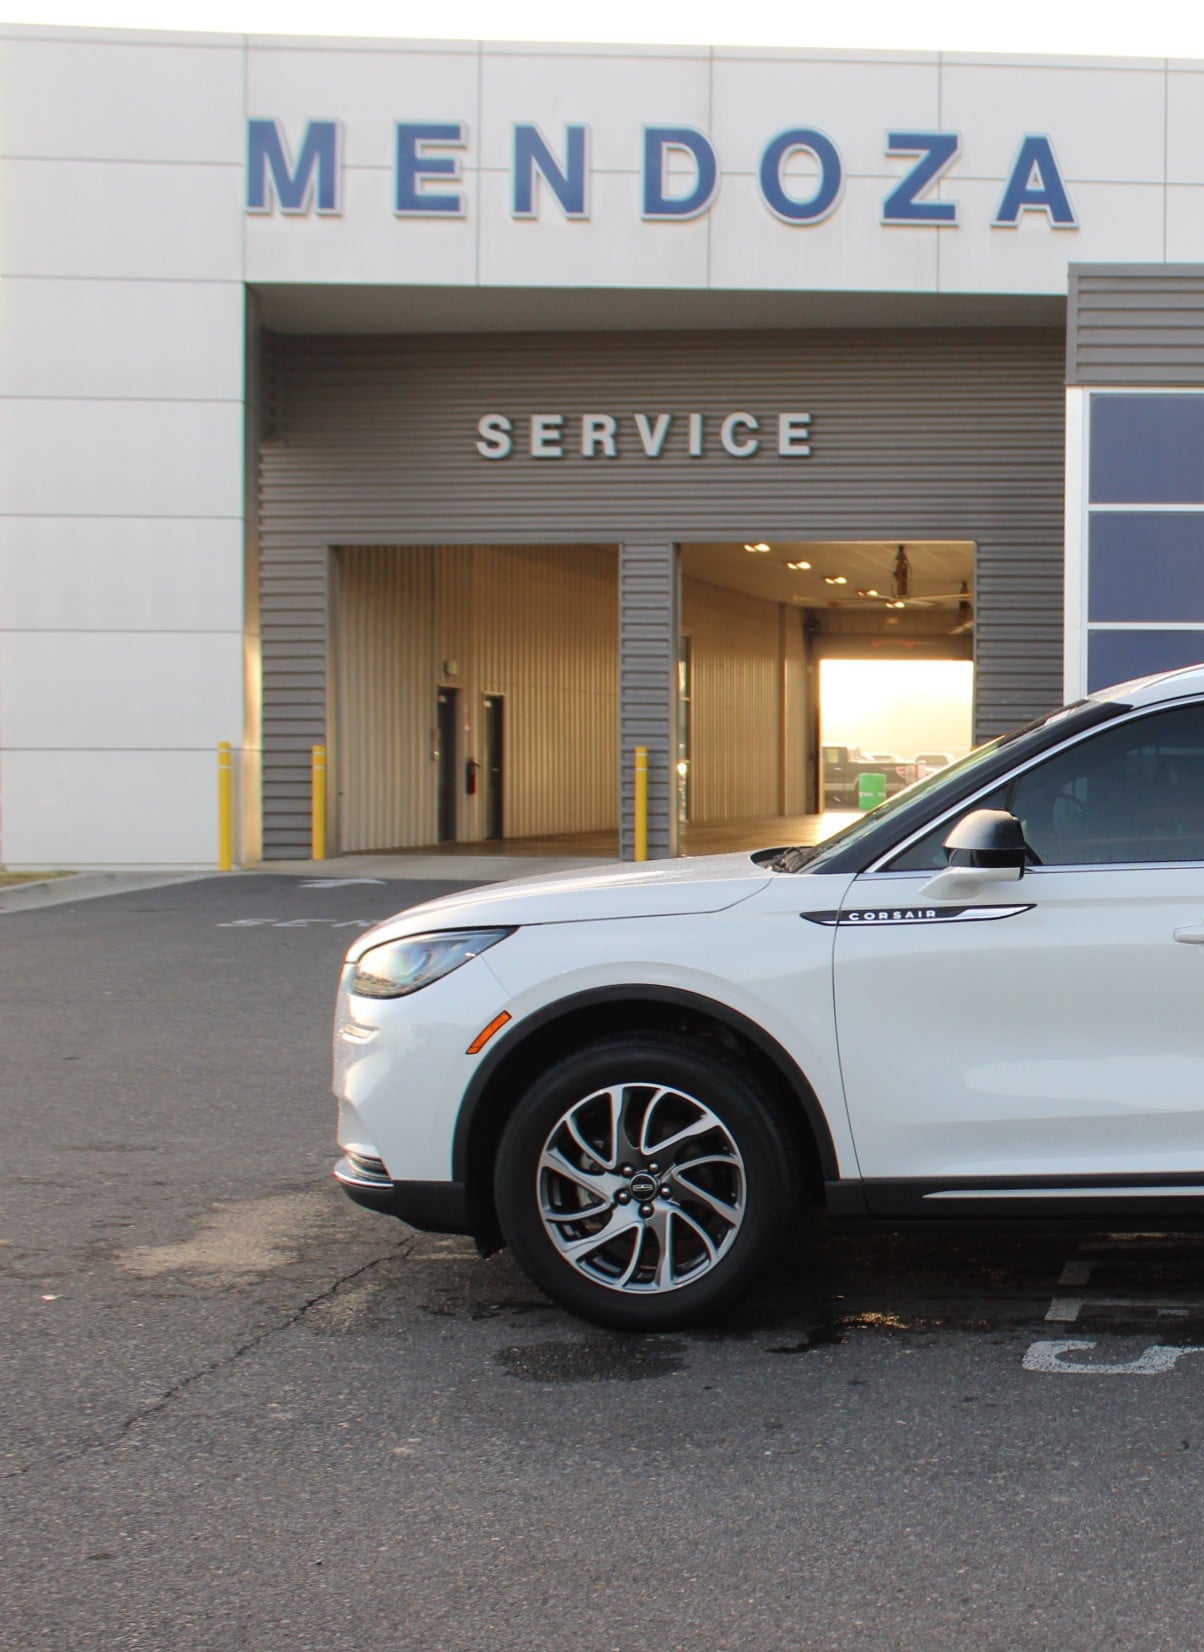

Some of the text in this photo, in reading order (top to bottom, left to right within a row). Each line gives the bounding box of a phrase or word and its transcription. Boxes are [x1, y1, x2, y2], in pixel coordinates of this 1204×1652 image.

[246, 117, 1080, 231] MENDOZA
[475, 412, 814, 460] SERVICE
[848, 909, 937, 921] CORSAIR
